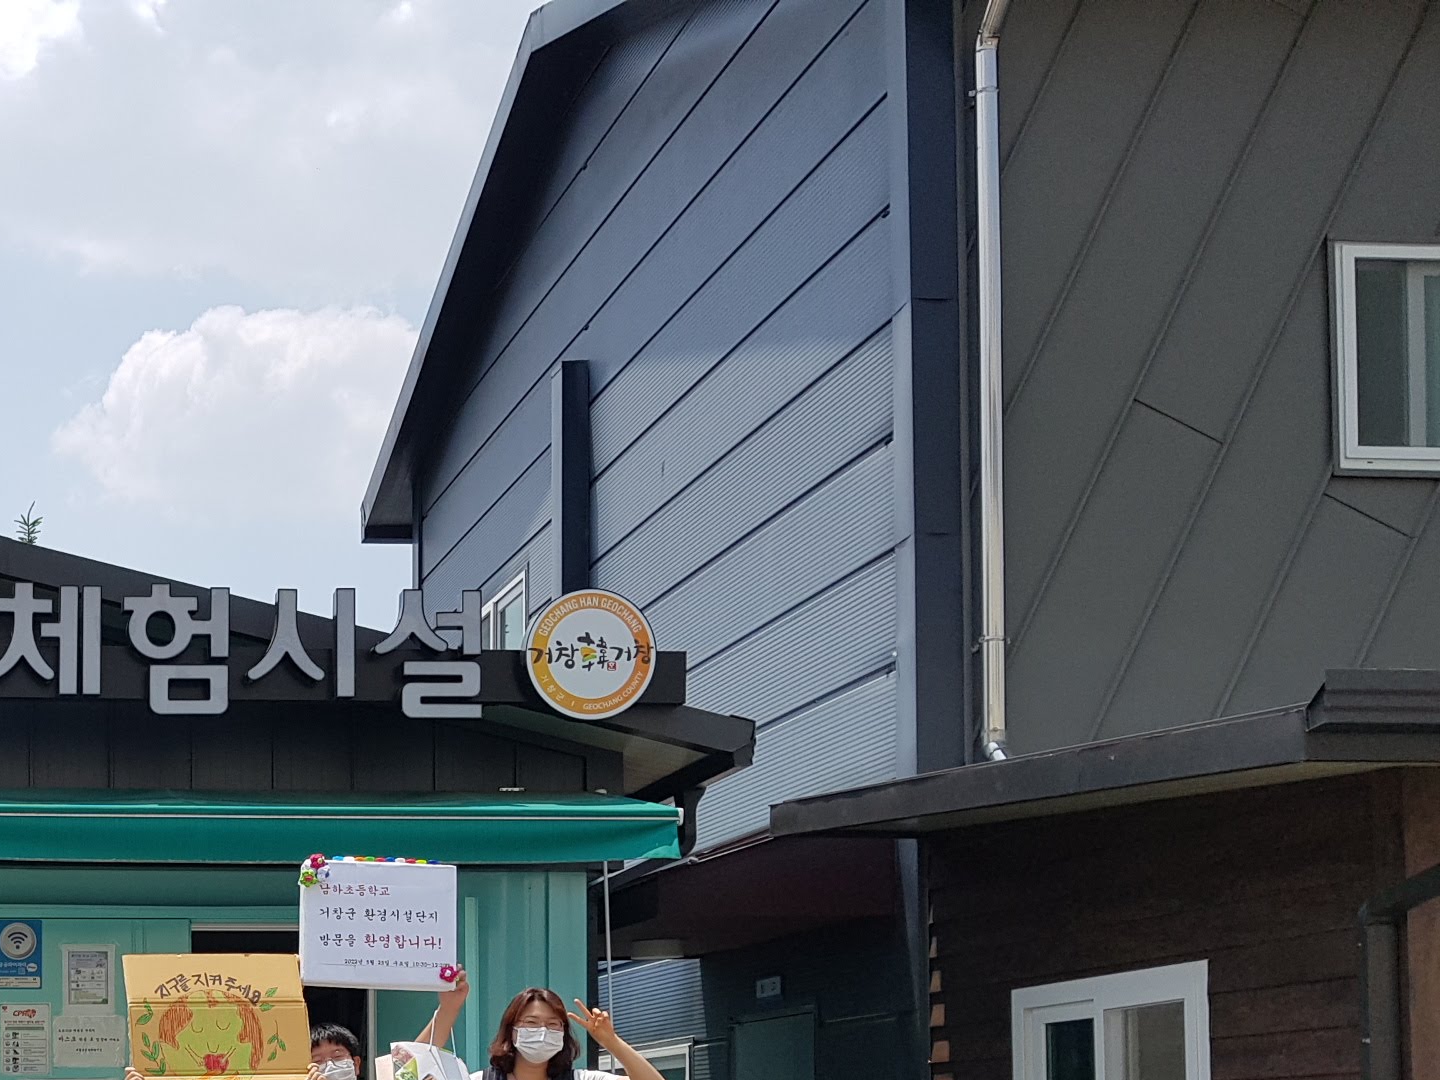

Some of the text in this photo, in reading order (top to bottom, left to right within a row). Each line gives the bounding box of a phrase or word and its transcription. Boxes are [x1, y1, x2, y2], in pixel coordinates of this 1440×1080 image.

[538, 597, 643, 637] GEOCHANG HAN GEOCHANG
[582, 671, 644, 711] GEOCHANG COUNTY
[319, 907, 439, 923] 거창군 환경시설단지
[320, 934, 442, 949] 방문을 환영합니다!
[154, 973, 191, 999] 지구를
[224, 976, 262, 1006] 주세요
